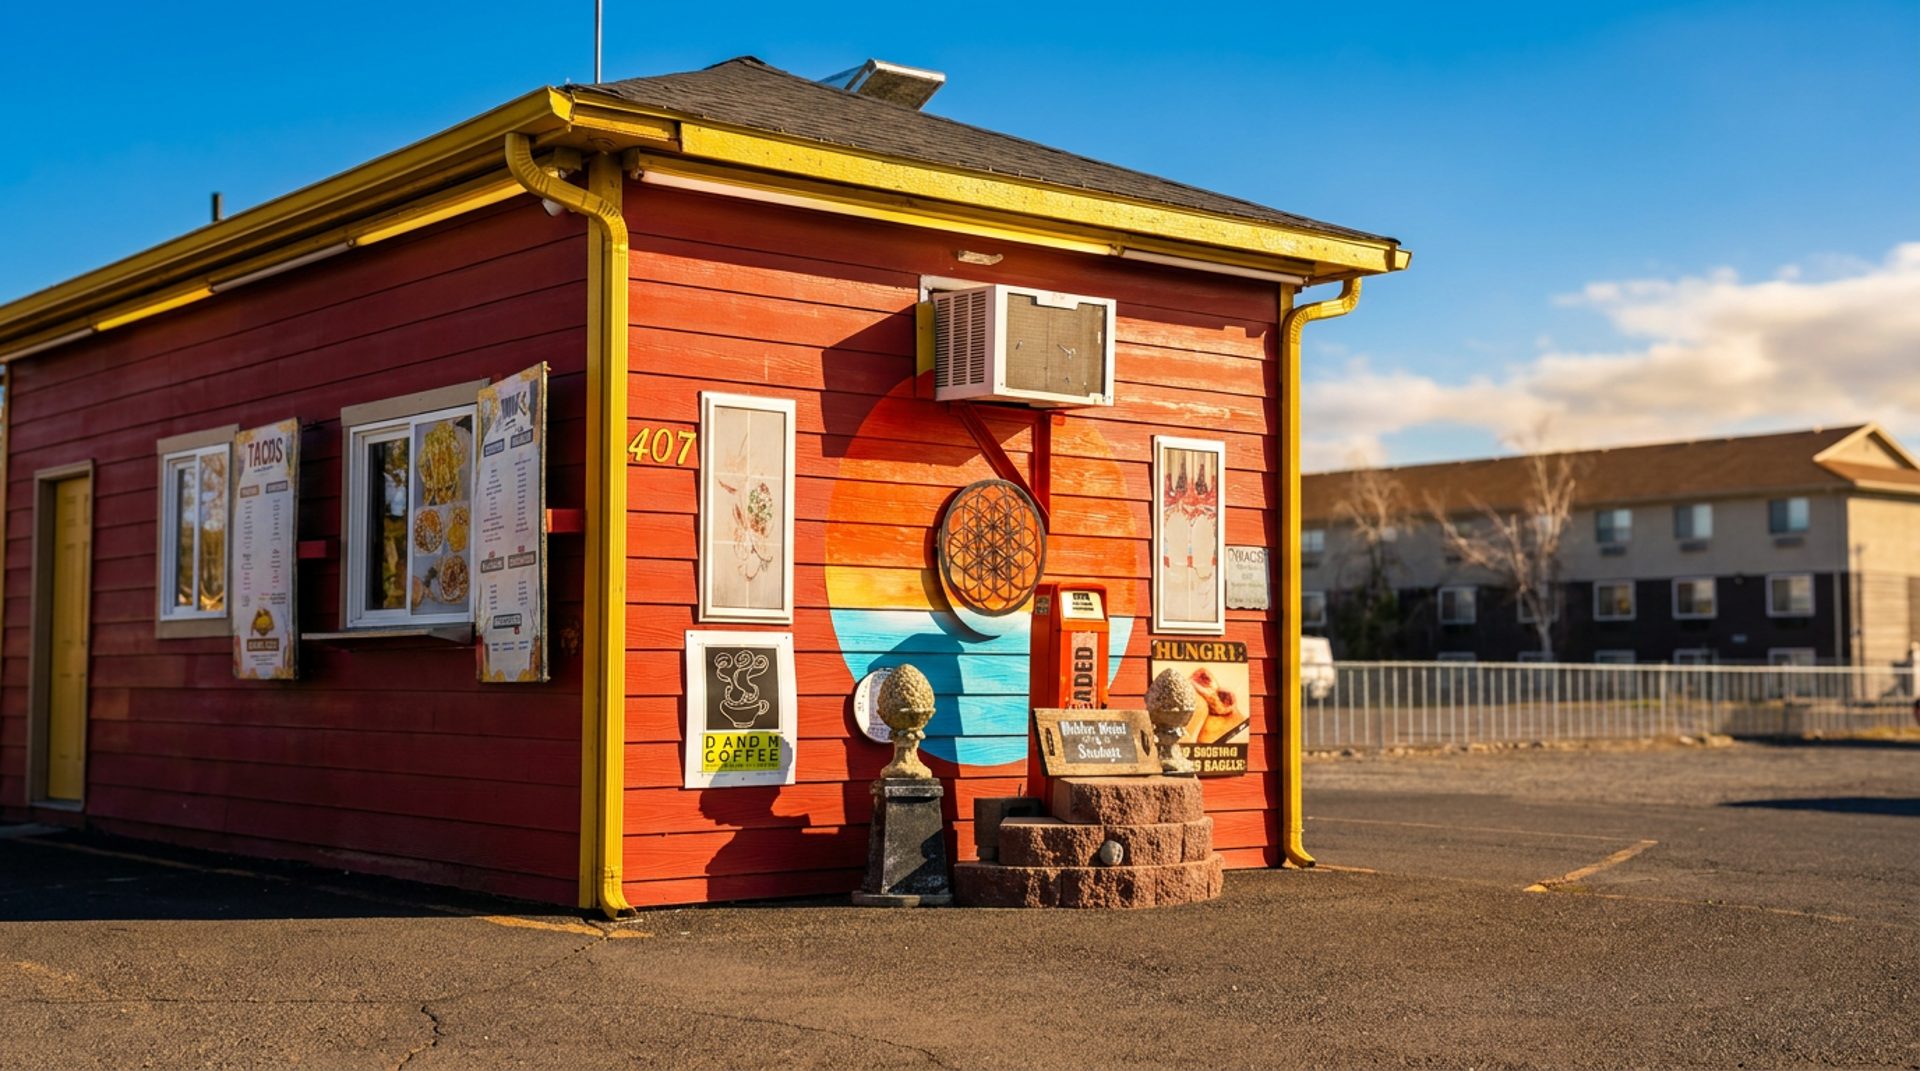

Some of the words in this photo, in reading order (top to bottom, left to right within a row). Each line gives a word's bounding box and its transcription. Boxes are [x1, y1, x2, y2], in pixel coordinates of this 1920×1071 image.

[629, 427, 697, 465] 407
[705, 736, 716, 749] D
[723, 736, 760, 749] AND
[768, 735, 779, 748] M
[705, 749, 779, 763] COFFEE
